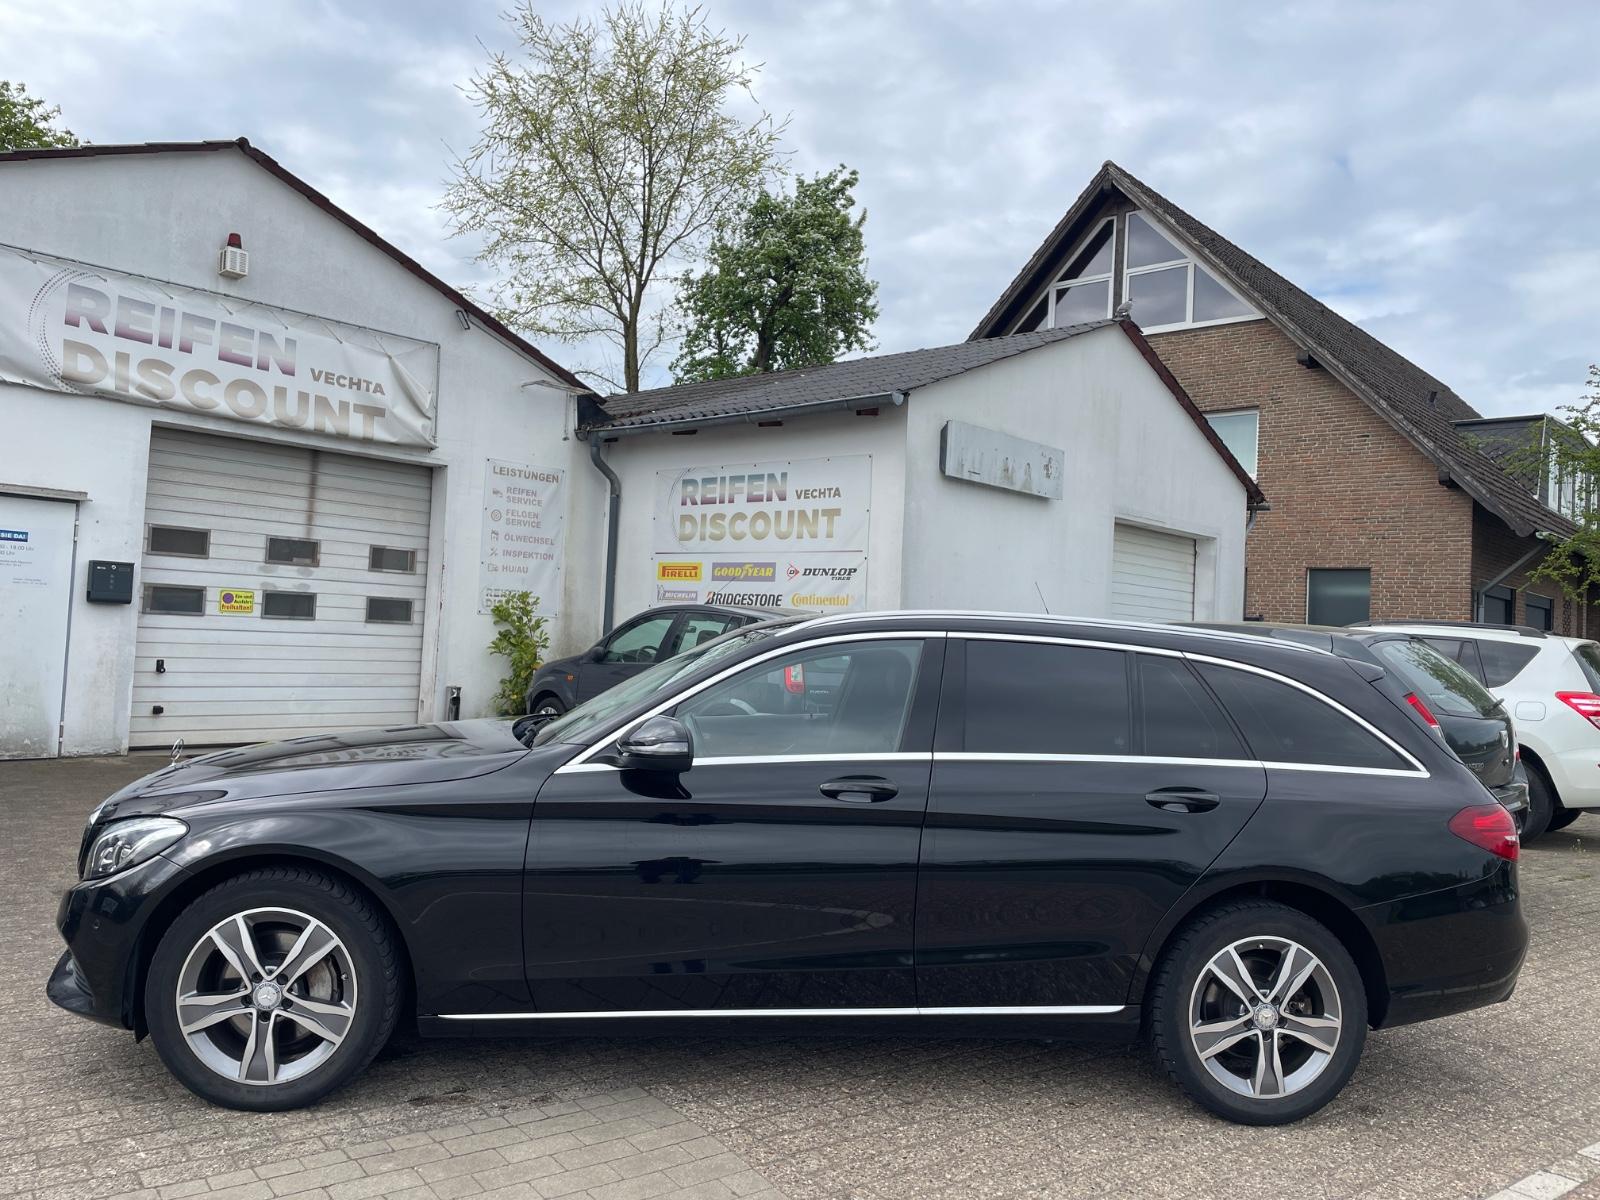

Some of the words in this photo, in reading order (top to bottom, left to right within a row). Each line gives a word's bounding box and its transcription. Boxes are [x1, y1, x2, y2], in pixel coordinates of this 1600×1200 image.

[65, 282, 297, 377] REIFEN
[310, 368, 386, 395] VECHTA
[61, 338, 386, 441] DISCOUNT
[493, 465, 559, 483] LEISTUNGEN
[506, 486, 537, 497] REIFEN
[680, 472, 788, 506] REIFEN
[795, 487, 842, 500] VECHTA
[505, 496, 543, 507] SERVICE
[505, 509, 539, 519] FELGEN
[505, 518, 542, 529] SERVICE
[679, 508, 841, 542] DISCOUNT
[502, 549, 554, 561] INSPEKTION
[502, 564, 529, 574] HU/AU
[661, 565, 699, 578] PIRELLI
[802, 568, 857, 576] DUNLOP
[664, 591, 697, 599] MICHELIN
[704, 591, 783, 607] BRIDGESTONE
[791, 592, 849, 607] Continental
